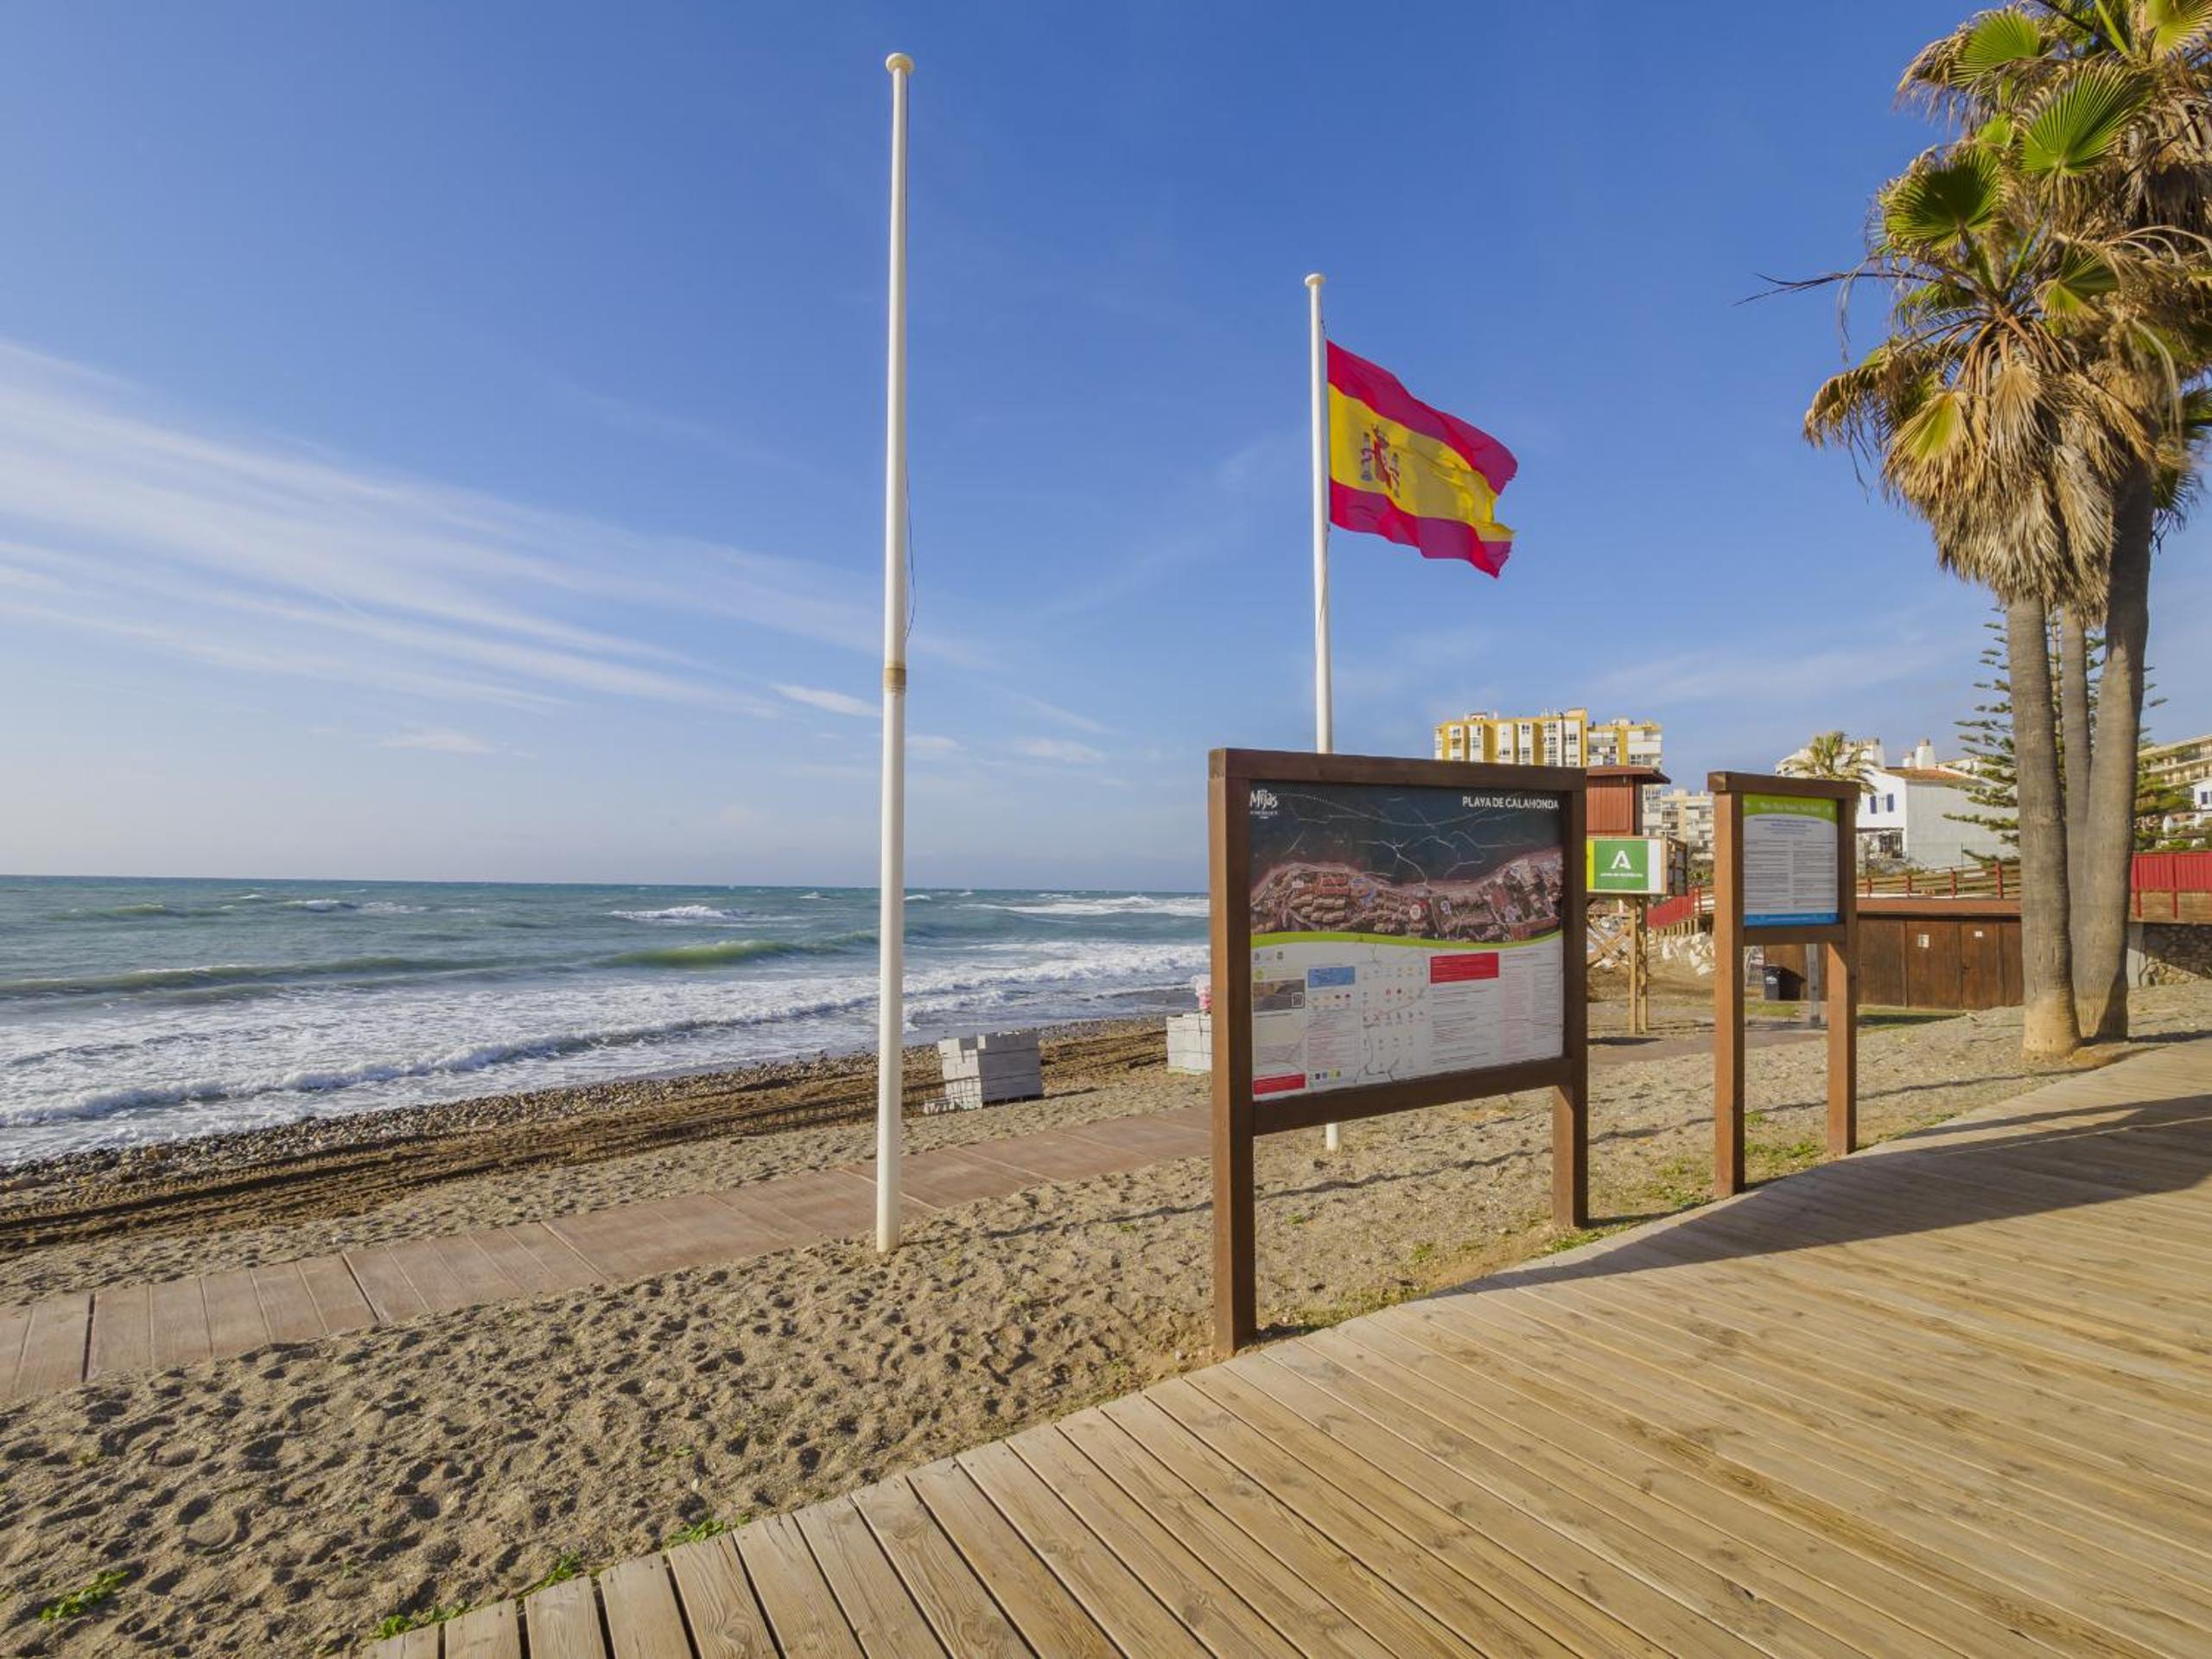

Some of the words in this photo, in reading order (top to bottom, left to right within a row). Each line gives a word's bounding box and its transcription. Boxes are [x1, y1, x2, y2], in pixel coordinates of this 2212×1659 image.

[1462, 796, 1491, 808] PLAYA
[1491, 797, 1505, 809] DE
[1505, 798, 1560, 810] CALAHONDA
